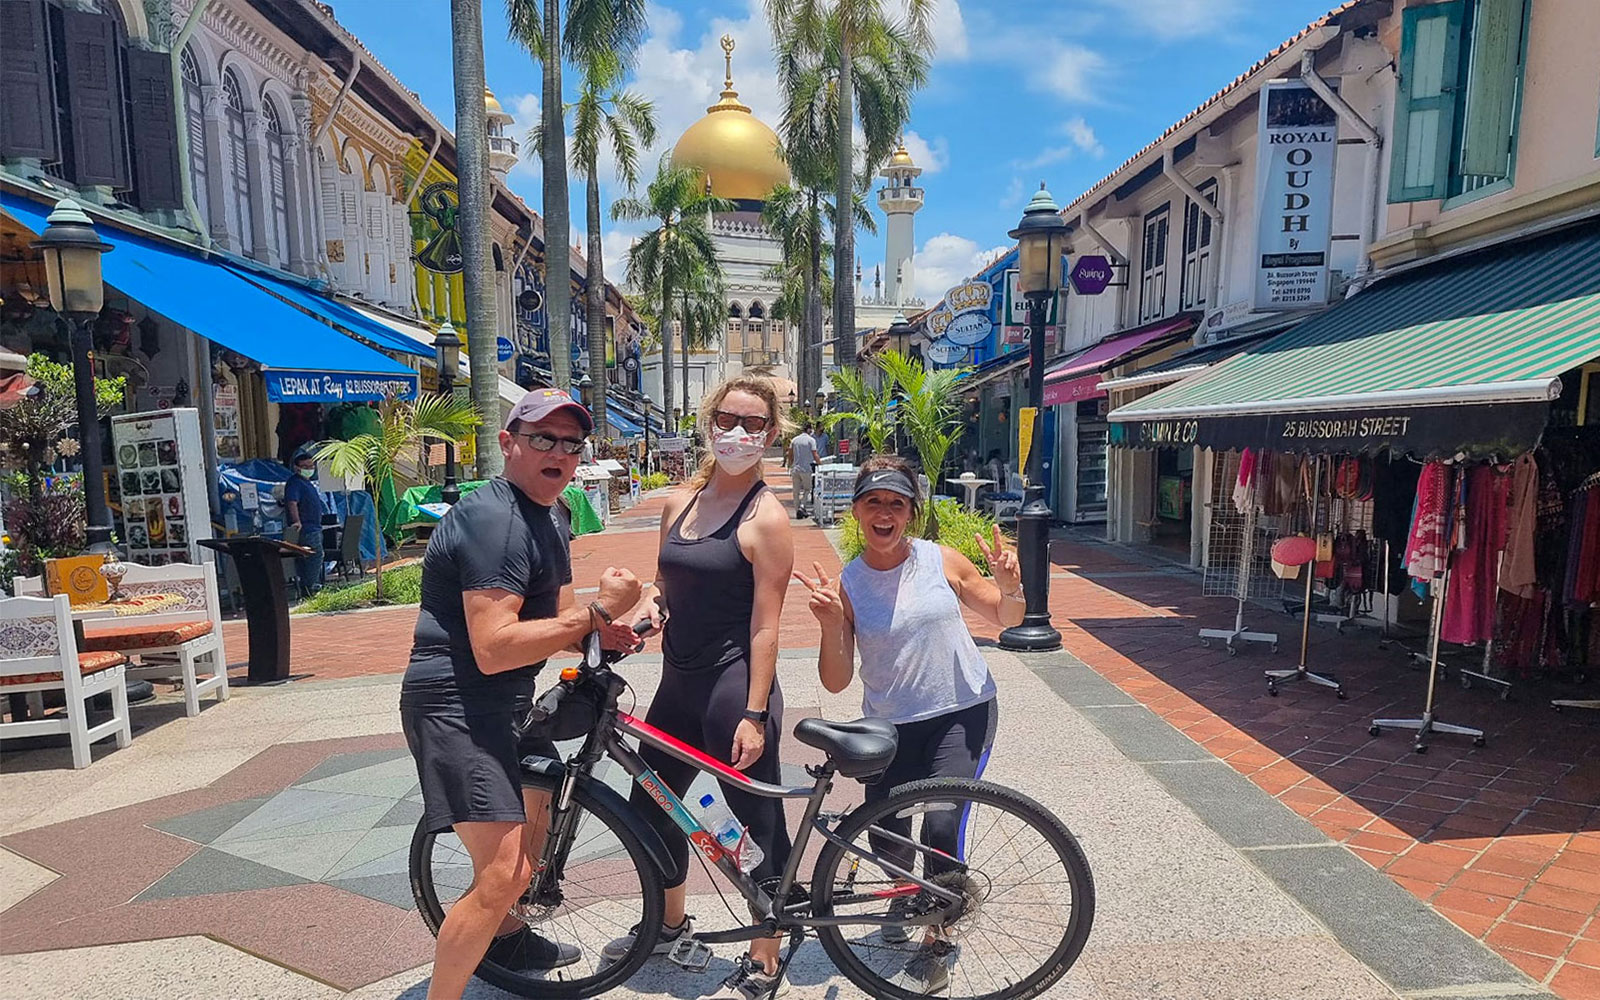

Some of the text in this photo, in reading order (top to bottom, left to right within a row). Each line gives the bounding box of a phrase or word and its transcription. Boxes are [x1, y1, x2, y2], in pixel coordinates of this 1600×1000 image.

[1269, 131, 1332, 144] ROYAL
[1281, 148, 1312, 233] OUDH
[1289, 238, 1300, 250] By
[955, 322, 983, 334] SULTAN
[279, 377, 310, 396] LEPAK
[311, 379, 320, 395] AT
[345, 379, 354, 394] 62
[1173, 421, 1181, 442] &
[1182, 420, 1198, 443] CO
[1282, 416, 1411, 438] 25 BUSSORAH STREET
[699, 838, 715, 857] SG
